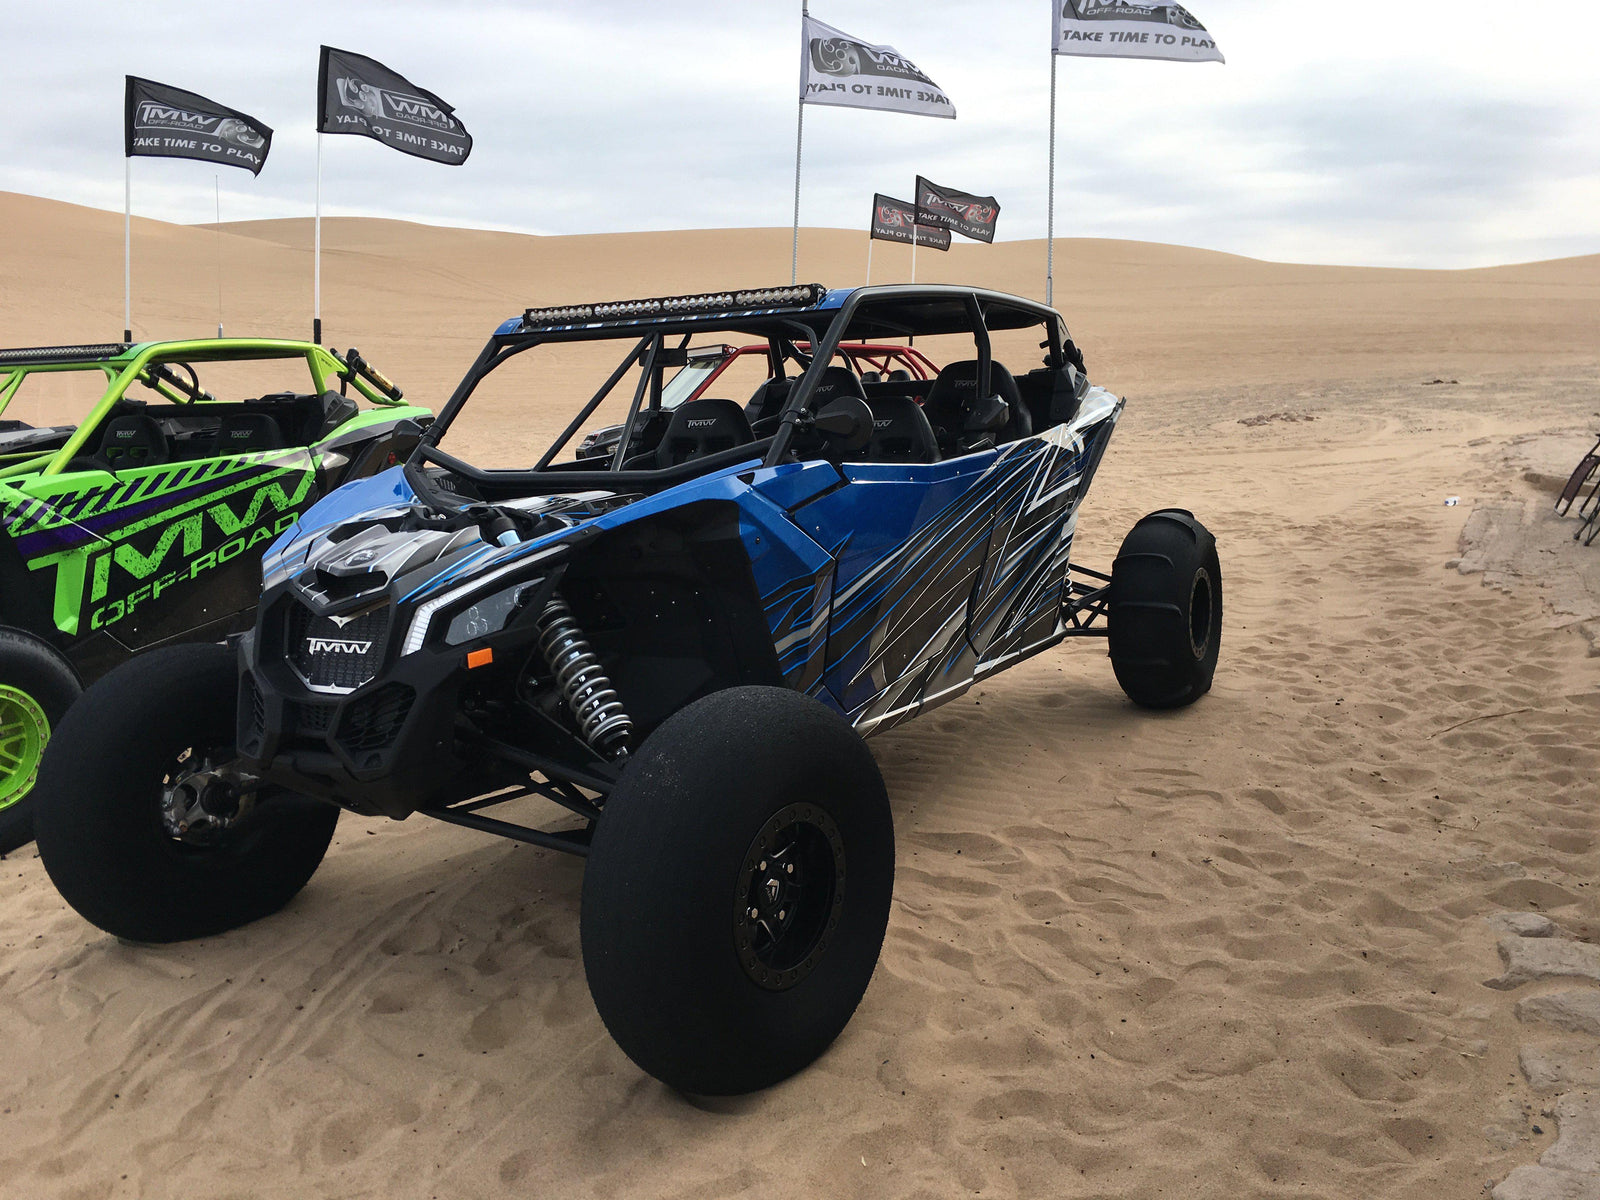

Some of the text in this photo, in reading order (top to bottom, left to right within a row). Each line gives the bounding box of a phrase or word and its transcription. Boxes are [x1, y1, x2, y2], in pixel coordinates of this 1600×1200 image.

[1086, 7, 1152, 16] OFF-ROAD
[1062, 29, 1216, 49] TAKE TIME TO PLAY
[142, 104, 220, 125] TMW
[147, 118, 204, 130] OFF-ROAD
[133, 137, 262, 165] TAKE TIME TO PLAY
[918, 212, 939, 222] TAKE
[940, 215, 959, 226] TIME
[959, 223, 970, 231] TO
[970, 226, 991, 237] PLAY
[687, 418, 717, 429] TMW
[26, 453, 324, 636] TMW
[90, 511, 301, 631] OFF-ROAD
[306, 637, 372, 655] TMW
